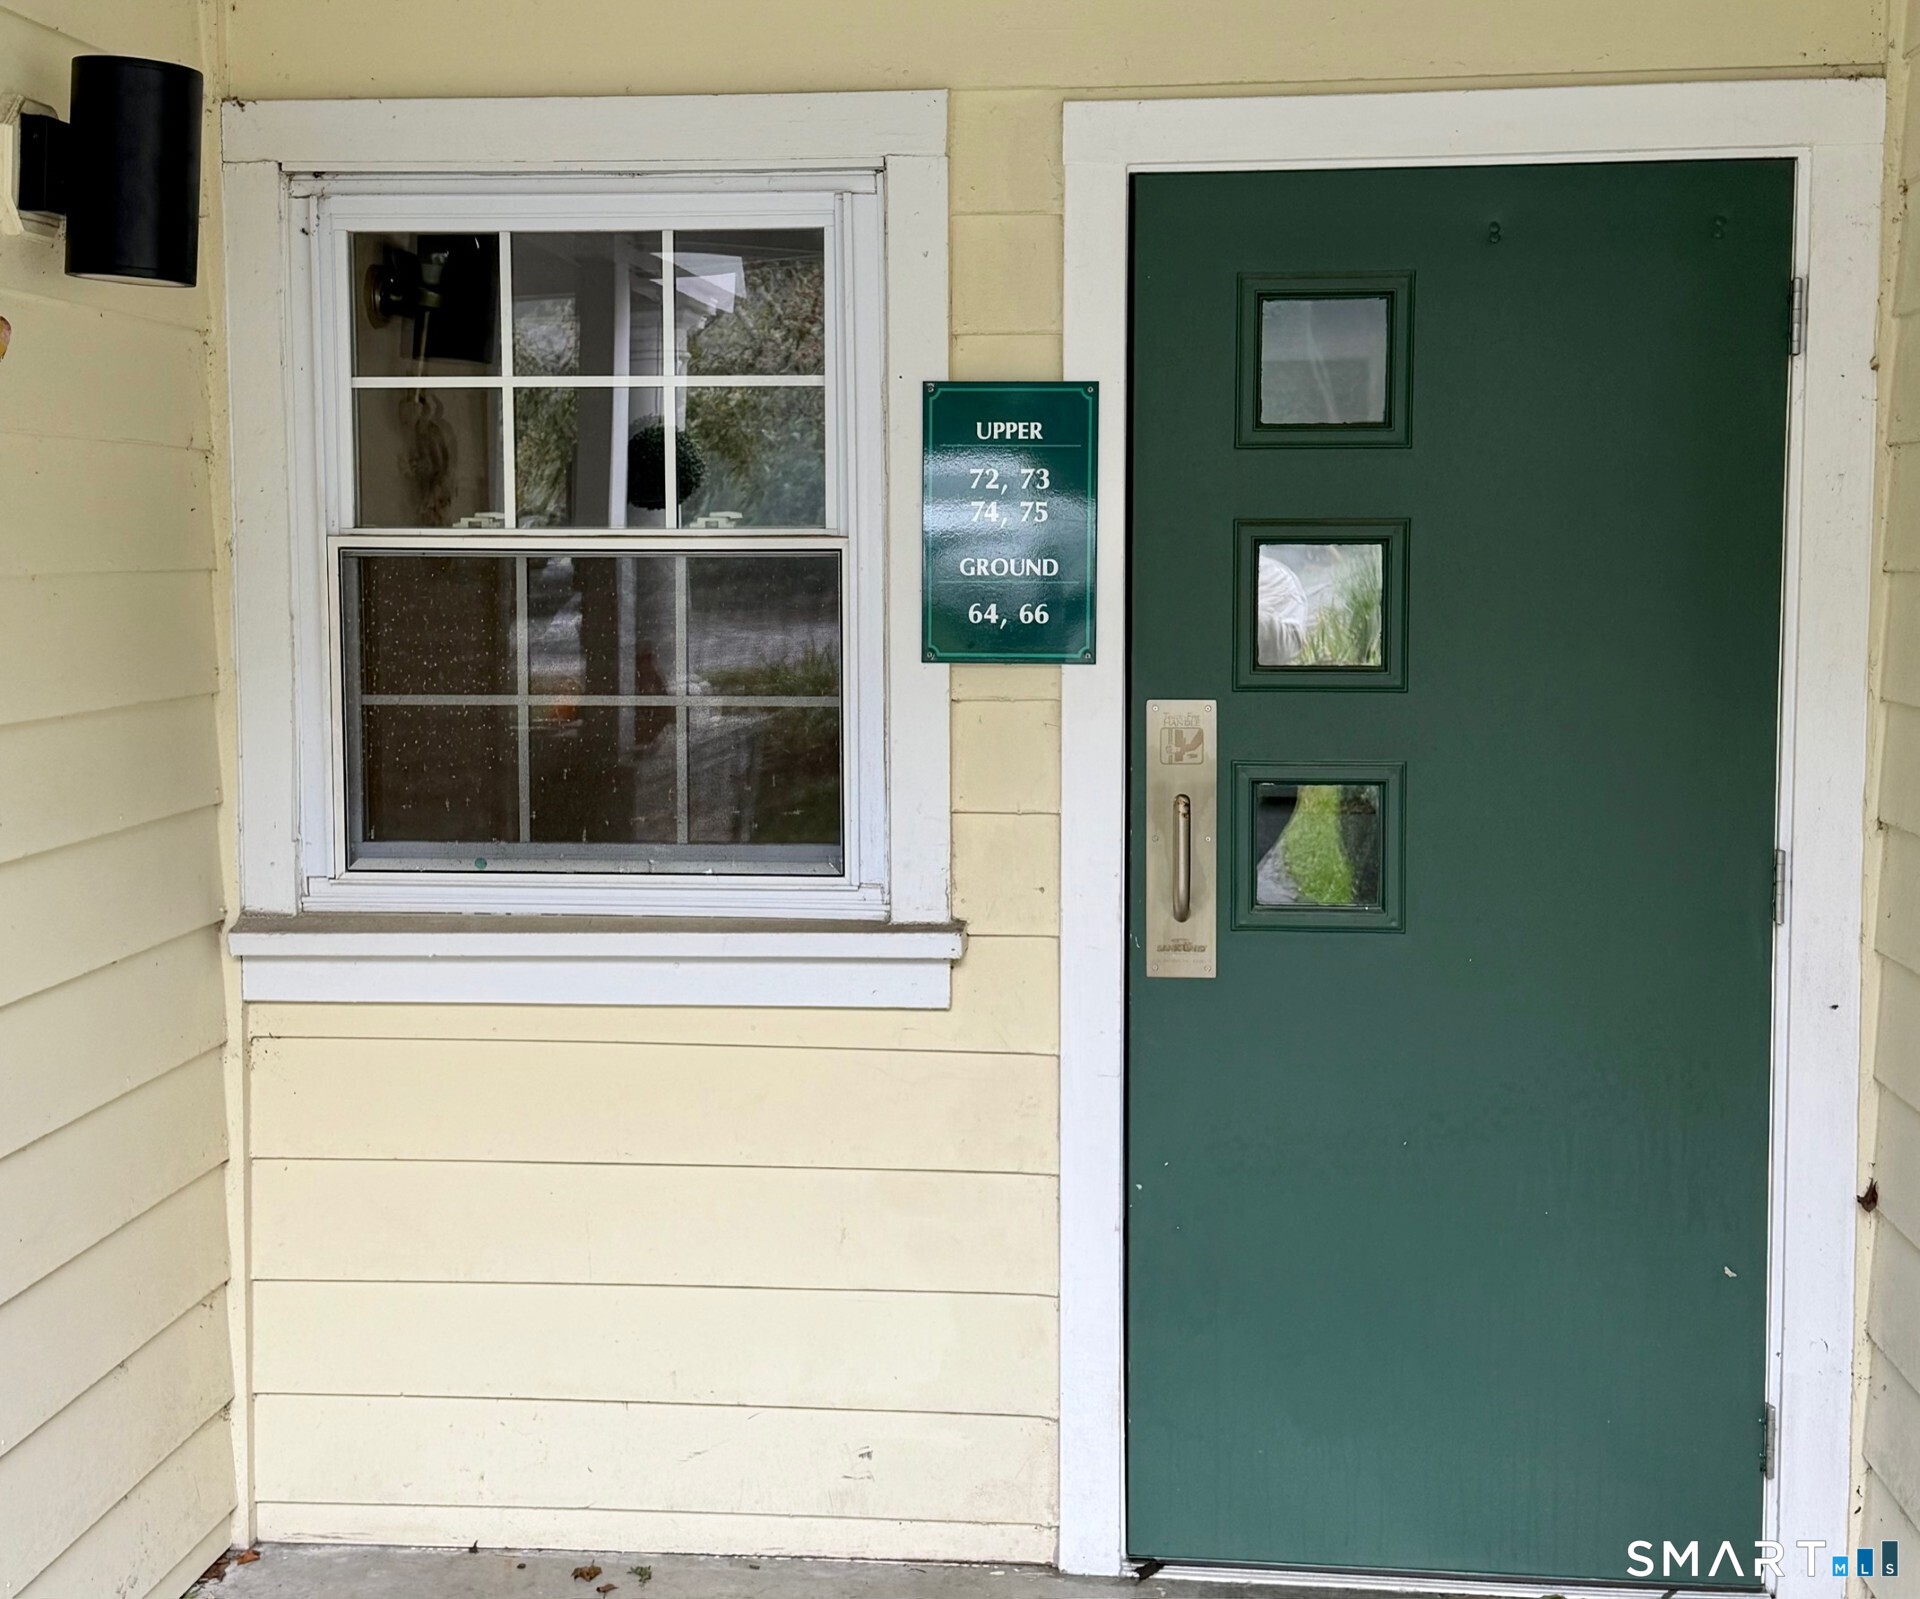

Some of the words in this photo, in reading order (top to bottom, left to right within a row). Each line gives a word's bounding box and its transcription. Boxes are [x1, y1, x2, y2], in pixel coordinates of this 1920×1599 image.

[976, 421, 1043, 440] UPPER
[969, 468, 1008, 495] 72,
[1020, 468, 1050, 490] 73
[970, 501, 1008, 528] 74,
[1020, 501, 1049, 523] 75
[959, 557, 1059, 577] GROUND
[968, 603, 1007, 629] 64,
[1019, 603, 1050, 625] 66
